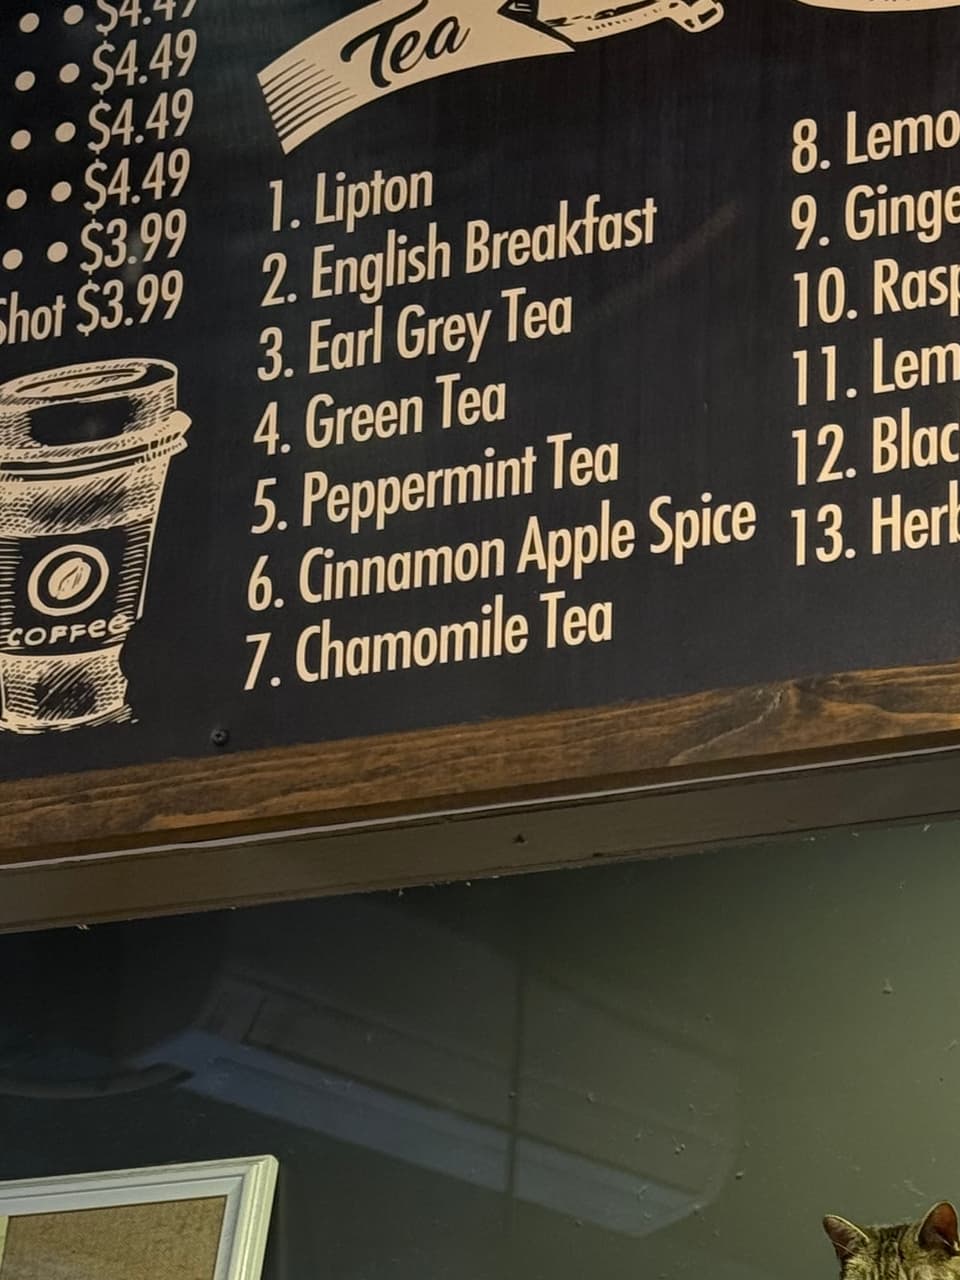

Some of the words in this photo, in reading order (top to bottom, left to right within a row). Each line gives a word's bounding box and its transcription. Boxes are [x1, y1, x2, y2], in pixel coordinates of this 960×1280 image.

[93, 30, 196, 94] $4.49
[340, 0, 470, 88] Tea
[89, 89, 193, 153] $4.49
[792, 119, 830, 173] 8.
[85, 149, 189, 214] $4.49
[270, 180, 299, 231] 1.
[316, 171, 432, 232] Lipton
[81, 209, 186, 275] $3.99
[262, 253, 296, 306] 2.
[312, 223, 450, 303] English
[466, 195, 657, 273] Breakfast
[792, 195, 829, 250] 9.
[77, 270, 183, 336] $3.99
[794, 267, 857, 327] 10.
[258, 327, 293, 380] 3.
[309, 306, 382, 373] Earl
[397, 305, 491, 362] Grey
[502, 287, 571, 341] Tea
[793, 346, 856, 405] 11.
[254, 402, 290, 454] 4.
[306, 394, 422, 448] Green
[436, 373, 505, 428] Tea
[252, 478, 287, 533] 5.
[303, 447, 536, 533] Peppermint
[547, 433, 618, 489] Tea
[792, 424, 856, 485] 12.
[248, 556, 283, 610] 6.
[300, 539, 504, 603] Cinnamon
[517, 516, 635, 583] Apple
[650, 493, 756, 565] Spice
[791, 504, 855, 566] 13.
[245, 633, 280, 690] 7.
[296, 594, 528, 682] Chamomile
[540, 591, 612, 648] Tea
